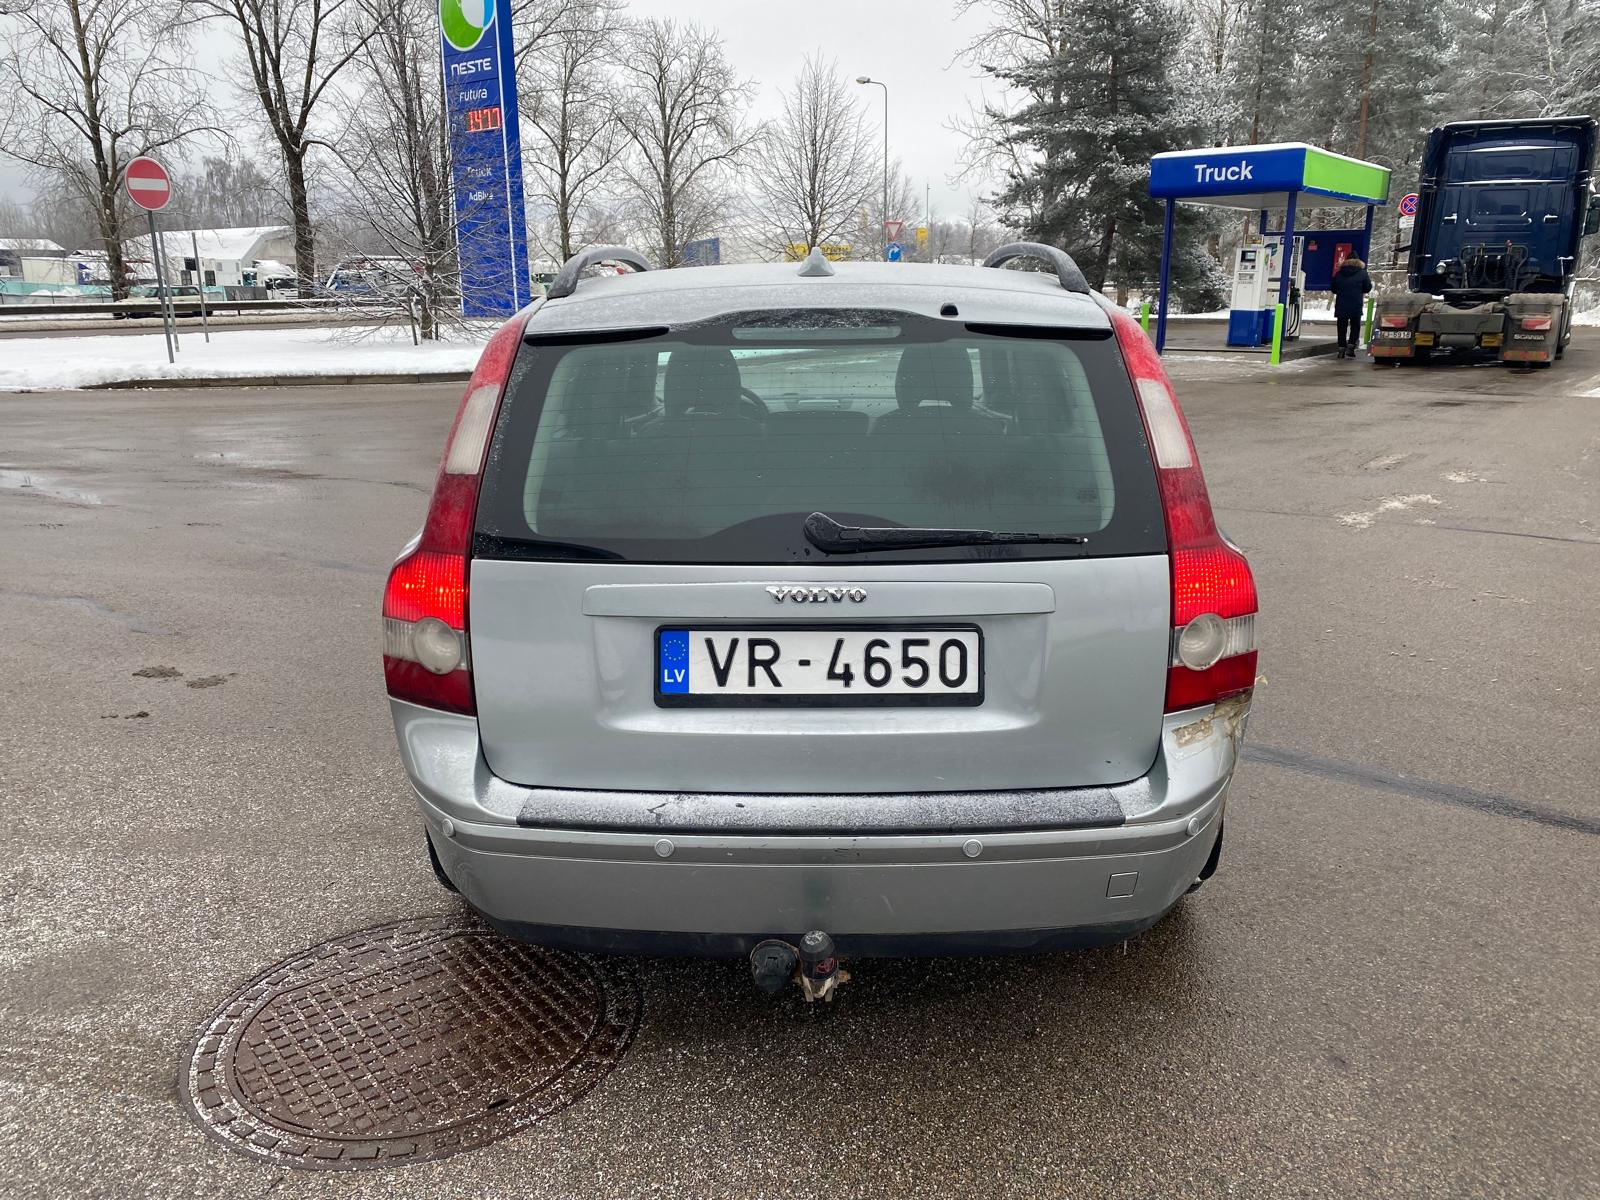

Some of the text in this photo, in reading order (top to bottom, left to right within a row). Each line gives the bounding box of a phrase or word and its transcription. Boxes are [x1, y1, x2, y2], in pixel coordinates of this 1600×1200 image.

[451, 58, 492, 76] NESTE
[460, 88, 488, 101] Futura
[1194, 160, 1254, 182] Truck
[766, 586, 867, 602] VOLVO
[704, 638, 968, 688] VR-4650
[664, 670, 686, 683] LV
